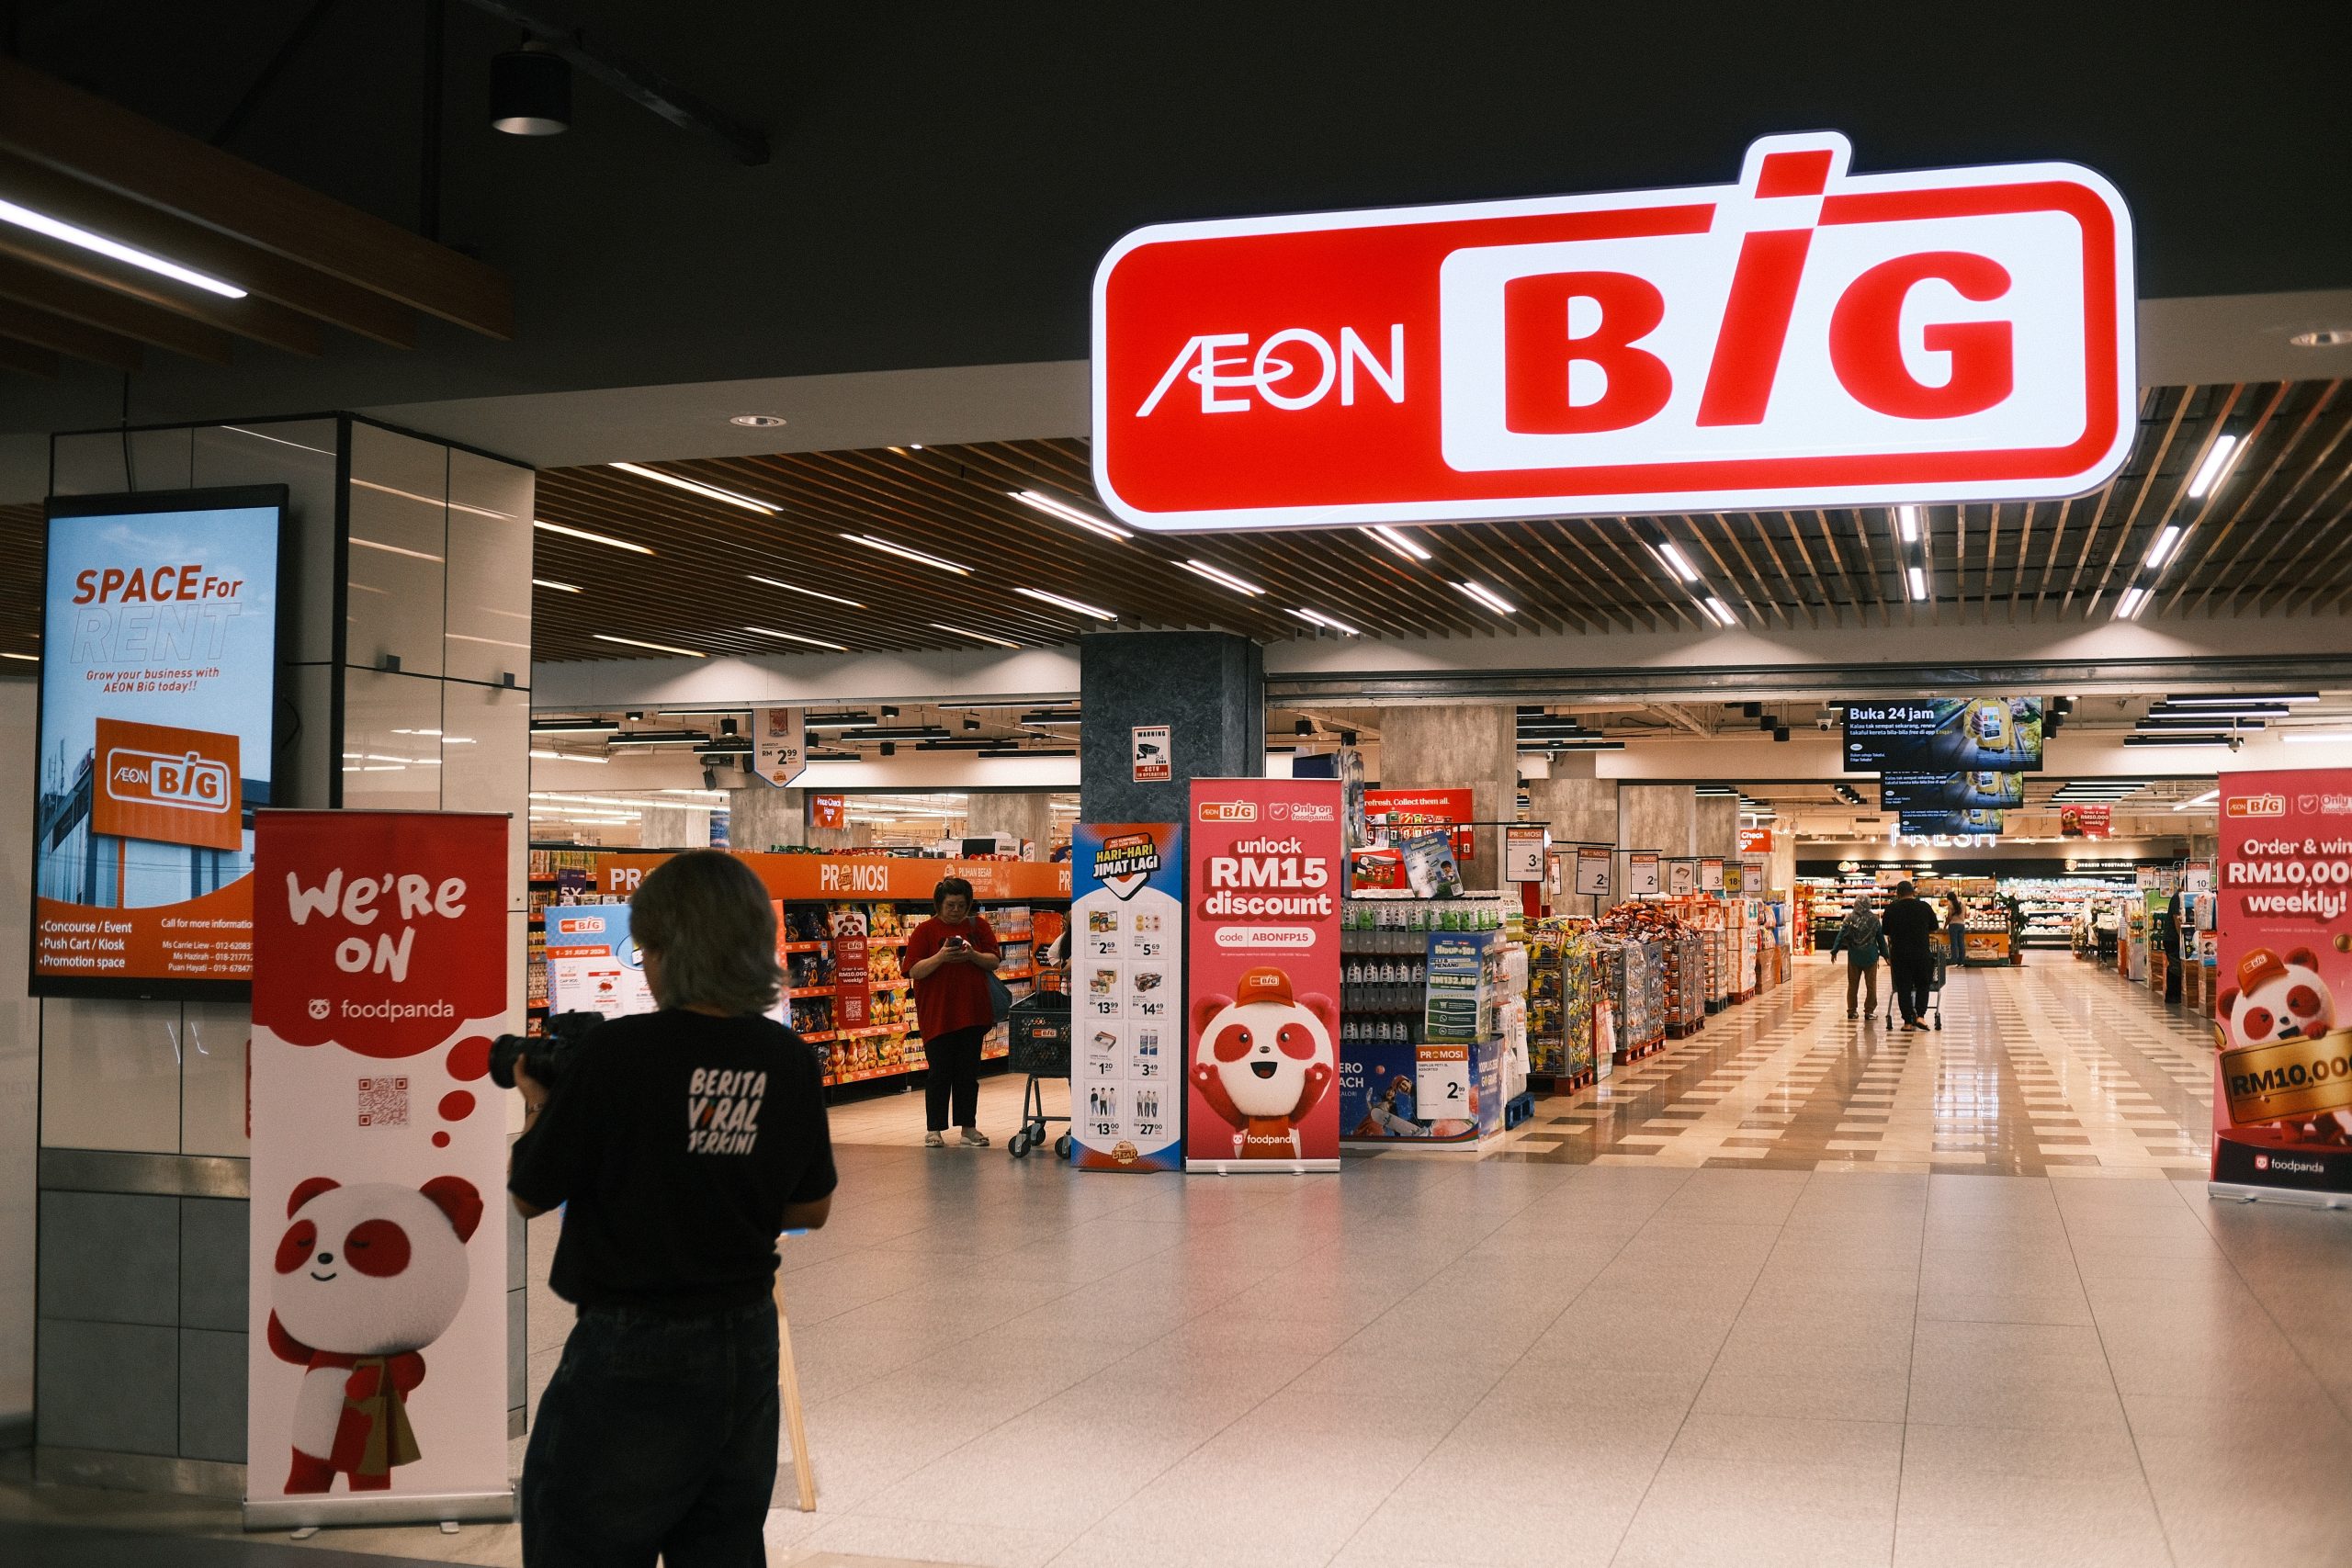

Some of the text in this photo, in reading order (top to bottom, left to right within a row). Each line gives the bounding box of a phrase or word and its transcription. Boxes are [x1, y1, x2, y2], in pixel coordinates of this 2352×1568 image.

[72, 564, 243, 605] SPACE For
[70, 603, 243, 663] RENT
[86, 667, 220, 685] Grow your business with
[103, 682, 133, 693] AEON
[158, 680, 198, 694] today!!
[1849, 706, 1934, 721] Buka 24 jam
[2322, 795, 2348, 806] Only
[823, 807, 835, 816] Here
[1292, 803, 1332, 814] Only on
[1292, 814, 1334, 822] foodpanda
[1237, 837, 1302, 853] unlock
[2244, 839, 2299, 854] Order
[2302, 839, 2317, 854] &
[1096, 843, 1153, 863] HARI-HARI
[1092, 855, 1158, 877] JIMAT LAGI
[1211, 857, 1329, 888] RM15
[1205, 890, 1332, 915] discount
[2247, 890, 2346, 919] weekly!
[44, 920, 96, 933] Concourse
[104, 921, 132, 933] Event
[161, 919, 175, 928] Call
[177, 919, 188, 928] for
[211, 919, 254, 929] informatio
[44, 938, 67, 950] Push
[69, 938, 90, 950] Cart
[98, 939, 125, 951] Kiosk
[1219, 932, 1308, 942] code ABONFP15
[215, 942, 254, 950] 012-62083
[43, 955, 126, 970] Promotion space
[341, 998, 455, 1022] foodpanda
[1340, 1062, 1363, 1074] ERO
[689, 1067, 767, 1098] BERITA
[1340, 1077, 1364, 1088] ACH
[688, 1097, 762, 1132] VIRAL
[687, 1130, 758, 1155] TERKINI
[1247, 1134, 1296, 1145] foodpanda
[2271, 1158, 2324, 1173] foodpanda
